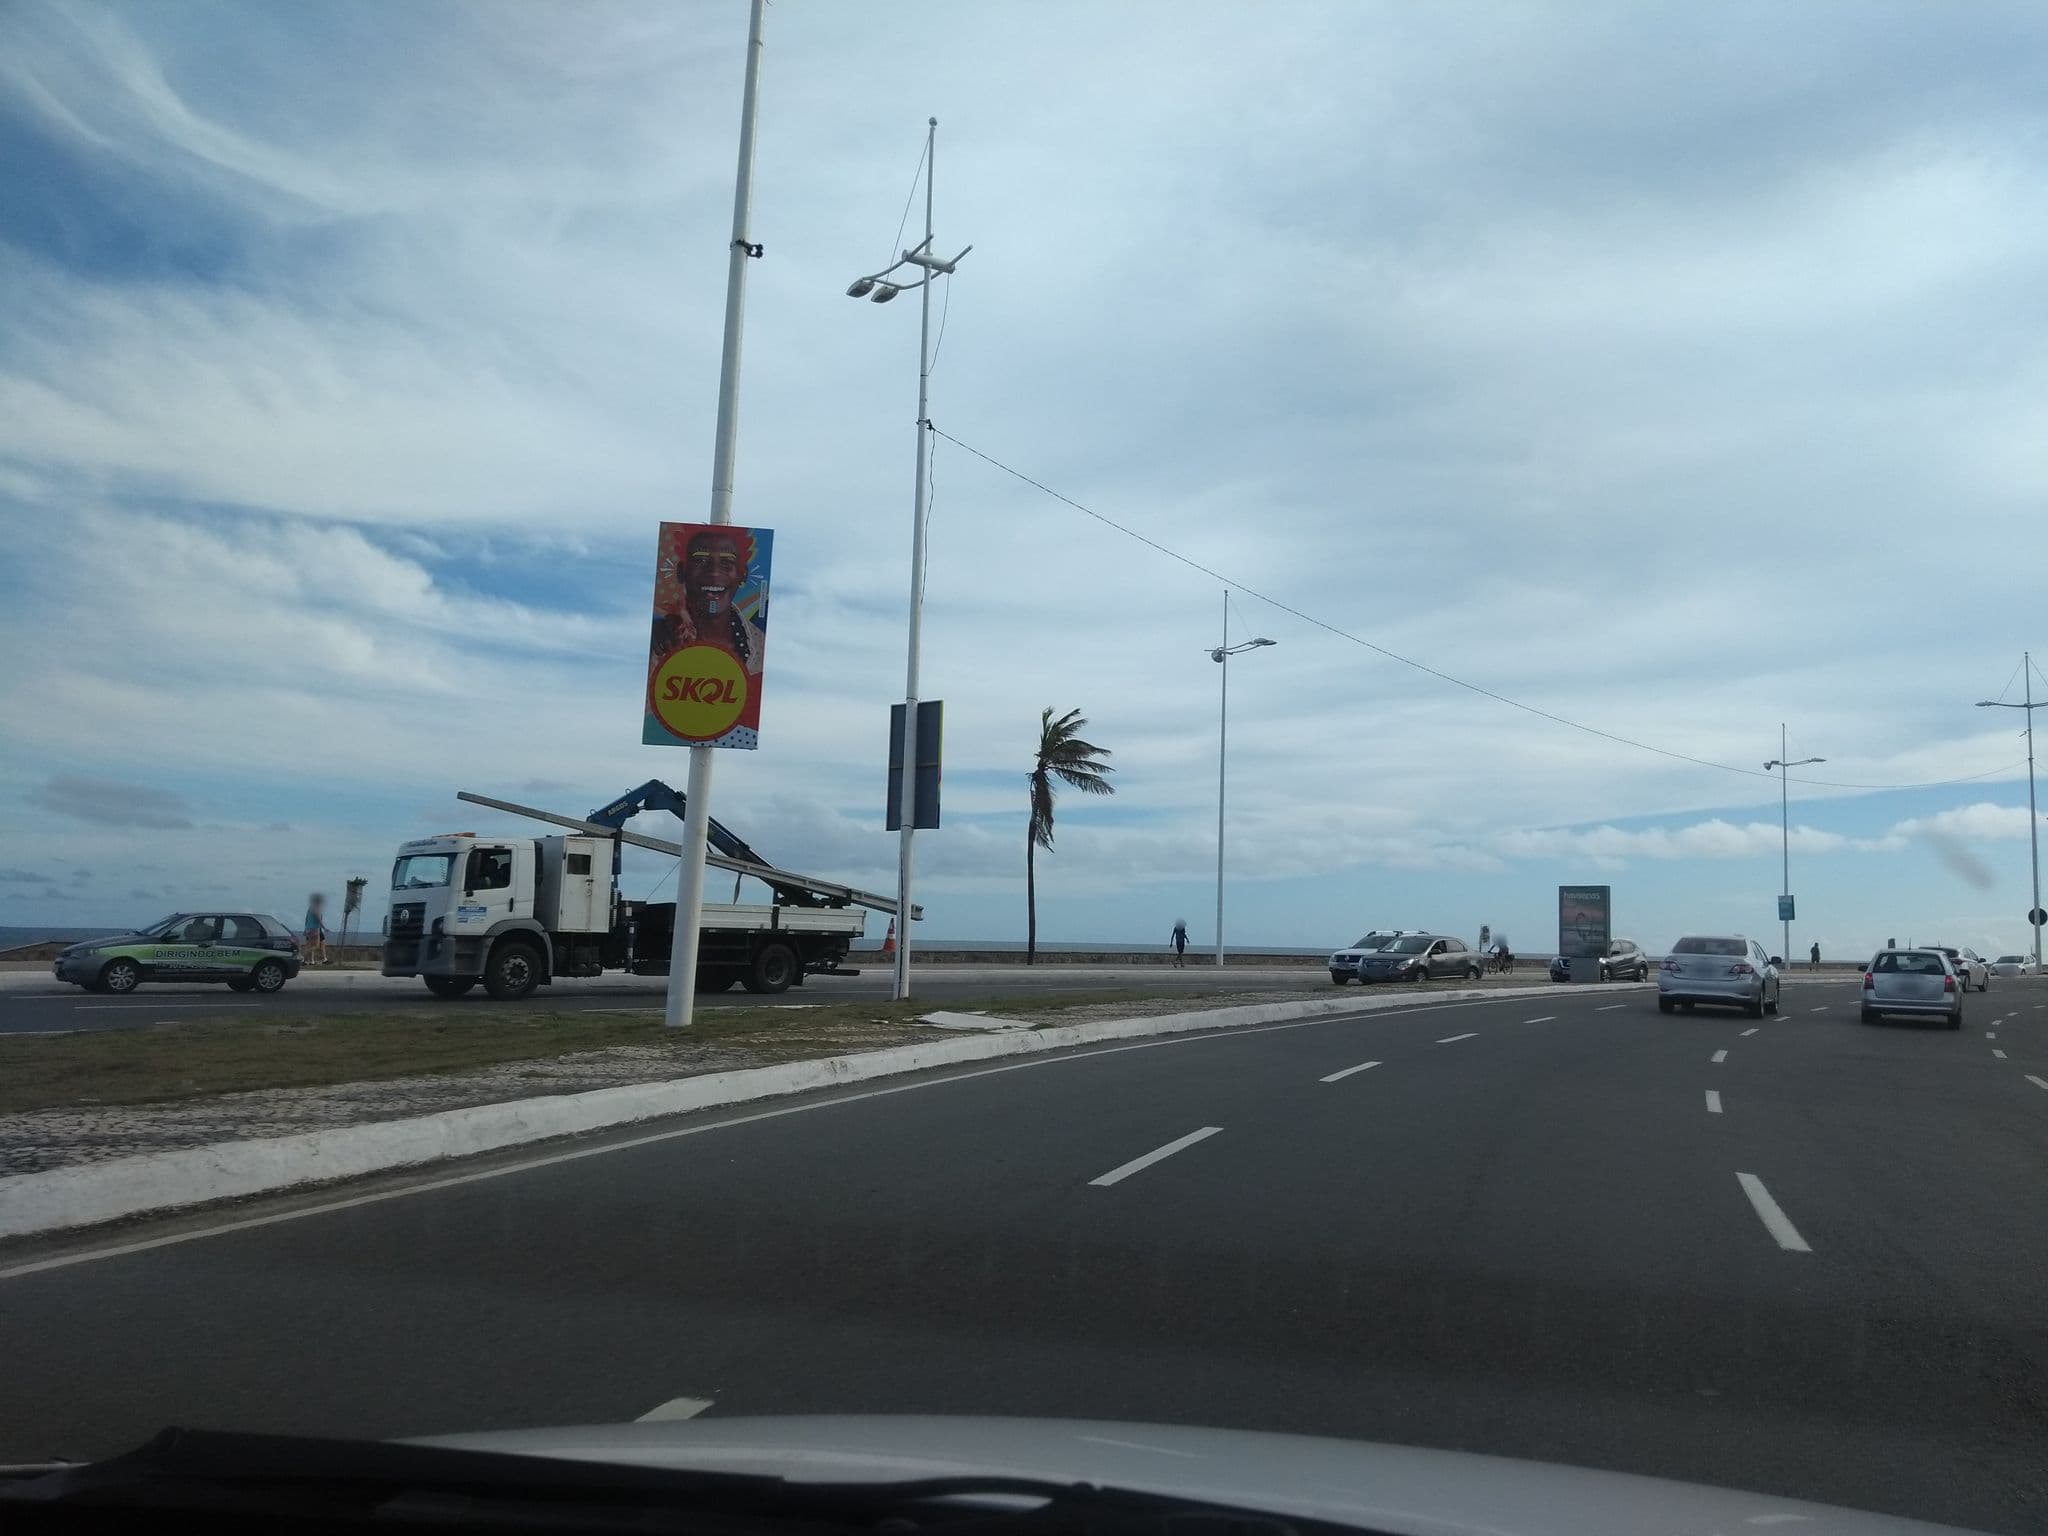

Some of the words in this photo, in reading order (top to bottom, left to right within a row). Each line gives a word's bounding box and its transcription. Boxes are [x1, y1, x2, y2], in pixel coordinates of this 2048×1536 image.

[662, 676, 738, 705] SKOL
[155, 949, 214, 959] DIRIGINDO
[217, 949, 241, 958] BEM
